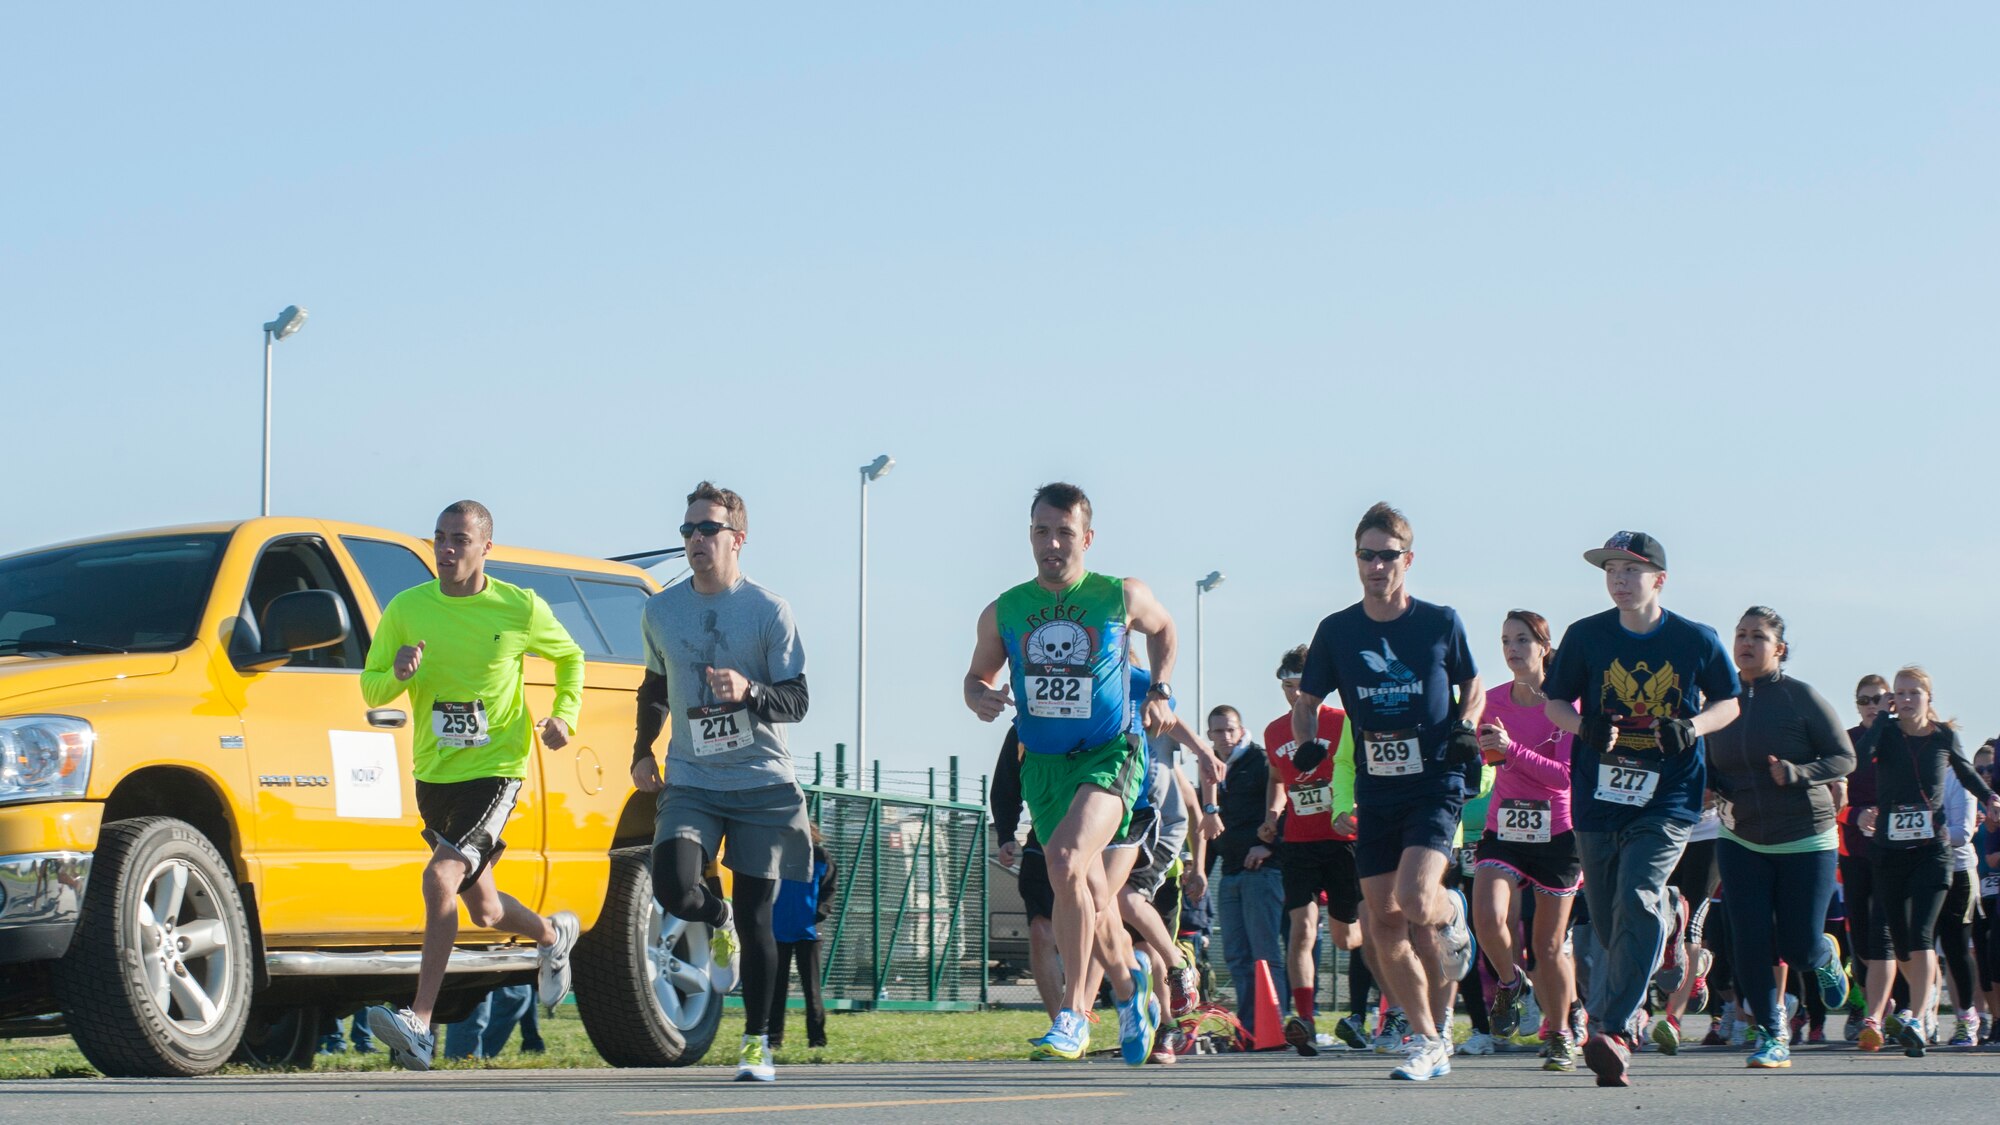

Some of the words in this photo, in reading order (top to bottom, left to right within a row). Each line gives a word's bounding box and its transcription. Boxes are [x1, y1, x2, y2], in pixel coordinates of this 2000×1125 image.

[1026, 604, 1088, 630] REBEL
[1035, 677, 1081, 701] 282
[442, 713, 480, 735] 259
[700, 714, 740, 740] 271
[1371, 742, 1410, 762] 269
[258, 775, 291, 788] RAM
[352, 768, 376, 783] NOVA
[1610, 767, 1649, 791] 277
[1298, 789, 1323, 806] 217
[1506, 809, 1542, 830] 283
[1895, 812, 1924, 829] 273
